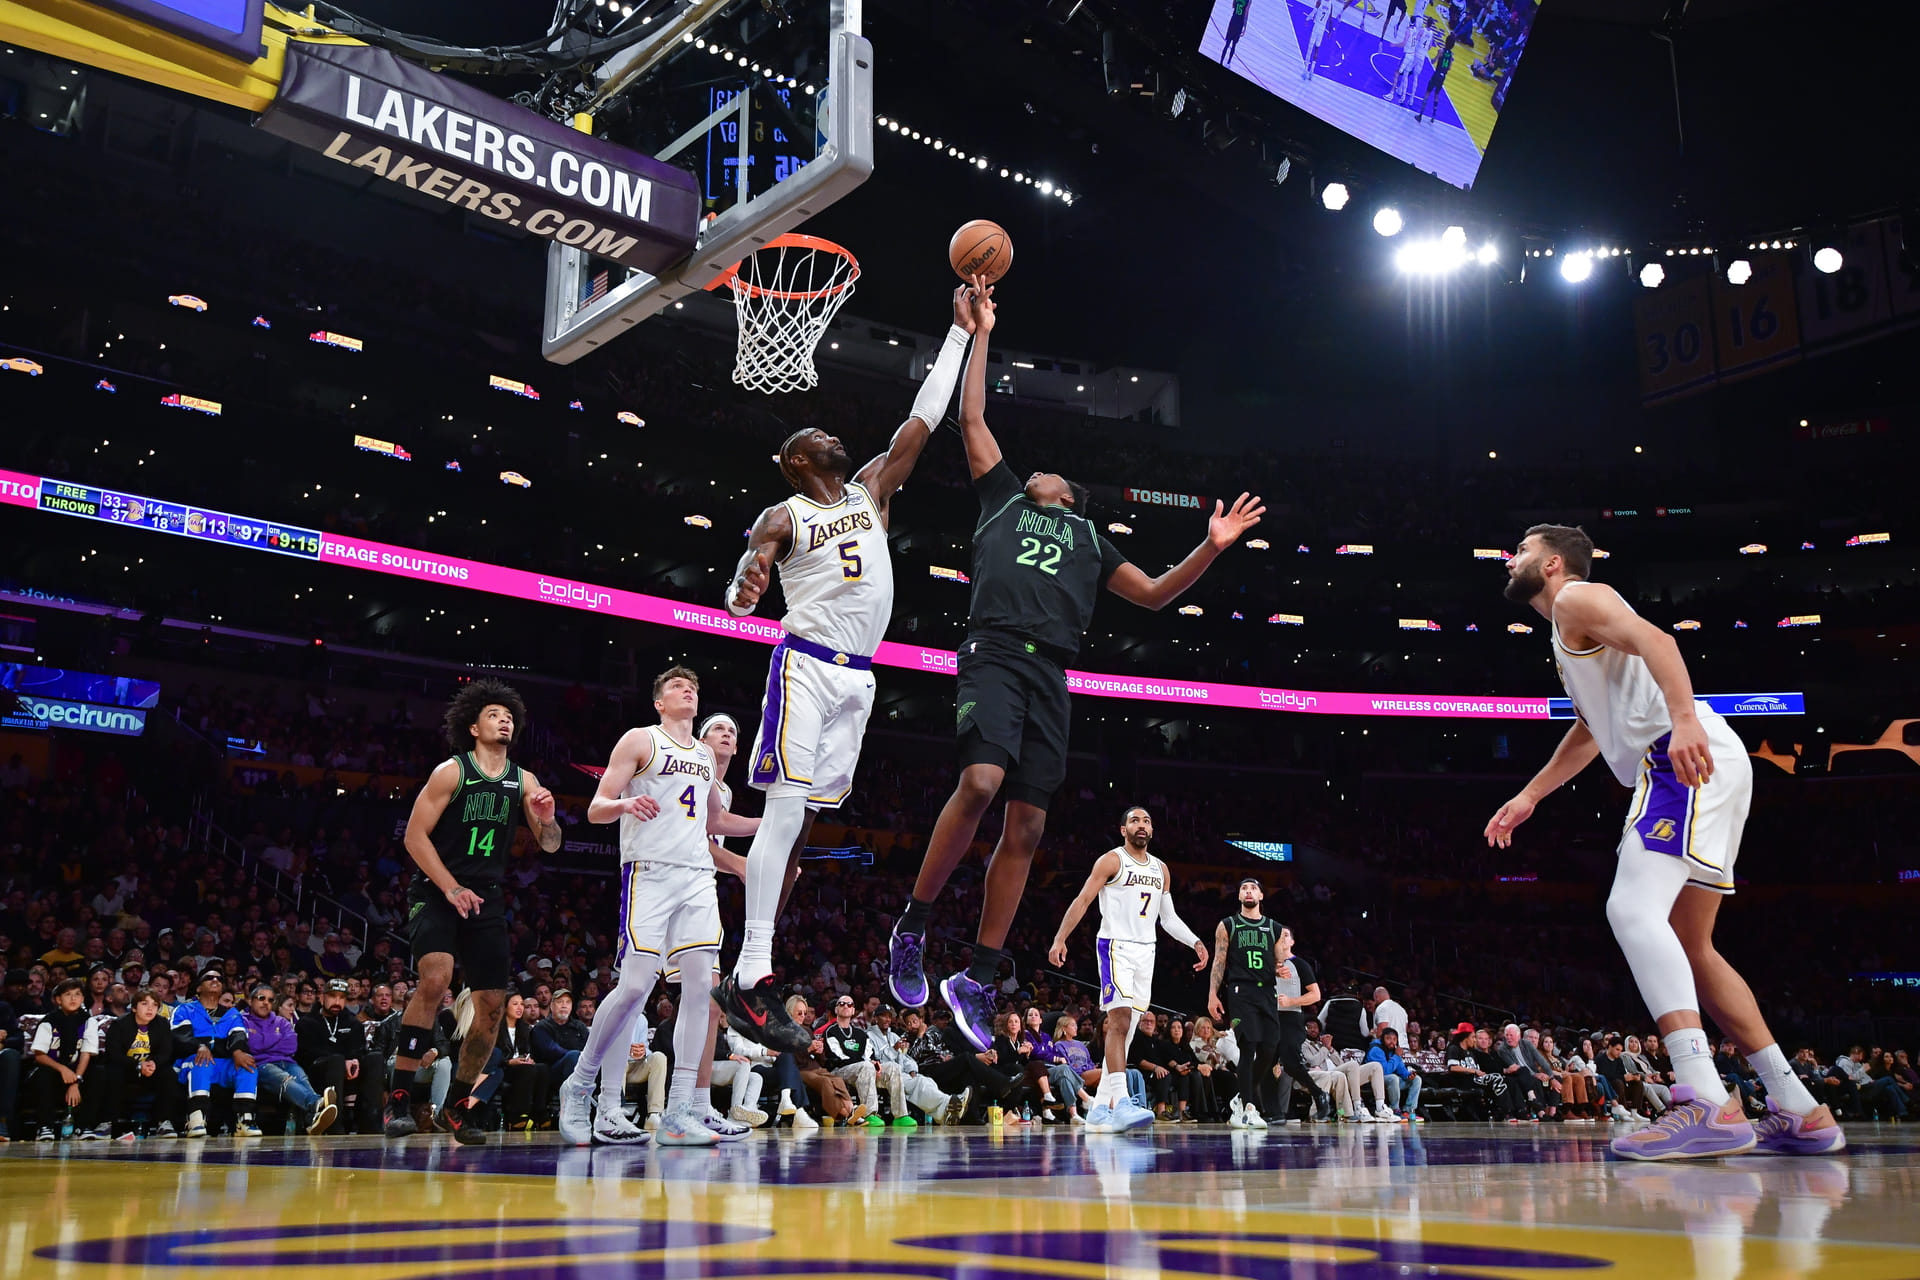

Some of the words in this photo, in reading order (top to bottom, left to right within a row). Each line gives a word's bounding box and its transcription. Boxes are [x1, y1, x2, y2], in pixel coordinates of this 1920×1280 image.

[345, 75, 652, 222] LAKERS.COM
[322, 131, 639, 259] LAKERS.COM
[961, 246, 996, 276] Wilson
[1729, 295, 1779, 350] 16
[1646, 321, 1701, 376] 30
[56, 484, 88, 500] FREE
[1130, 488, 1201, 509] TOSHIBA
[44, 496, 96, 515] THROWS
[111, 508, 128, 522] 37
[151, 516, 169, 530] 18
[200, 517, 226, 536] 113
[241, 525, 263, 543] 97
[806, 511, 873, 554] LAKERS
[1016, 509, 1074, 551] NOLA
[270, 535, 279, 546] 4
[279, 532, 318, 553] 9:15
[381, 552, 469, 580] SOLUTIONS
[838, 540, 863, 582] 5
[1016, 537, 1062, 575] 22
[538, 577, 611, 608] boldyn
[673, 608, 737, 632] WIRELESS
[1084, 678, 1144, 694] COVERAGE
[1146, 685, 1209, 699] SOLUTIONS
[1259, 690, 1317, 710] boldyn
[1371, 700, 1431, 711] WIRELESS
[1433, 702, 1494, 713] COVERAGE
[1769, 702, 1788, 711] Bank
[657, 754, 711, 782] LAKERS
[462, 791, 510, 825] NOLA
[677, 784, 696, 820] 4
[467, 826, 495, 857] 14
[1123, 871, 1161, 890] LAKERS
[1139, 892, 1151, 918] 7
[1237, 929, 1269, 951] NOLA
[1246, 950, 1264, 970] 15
